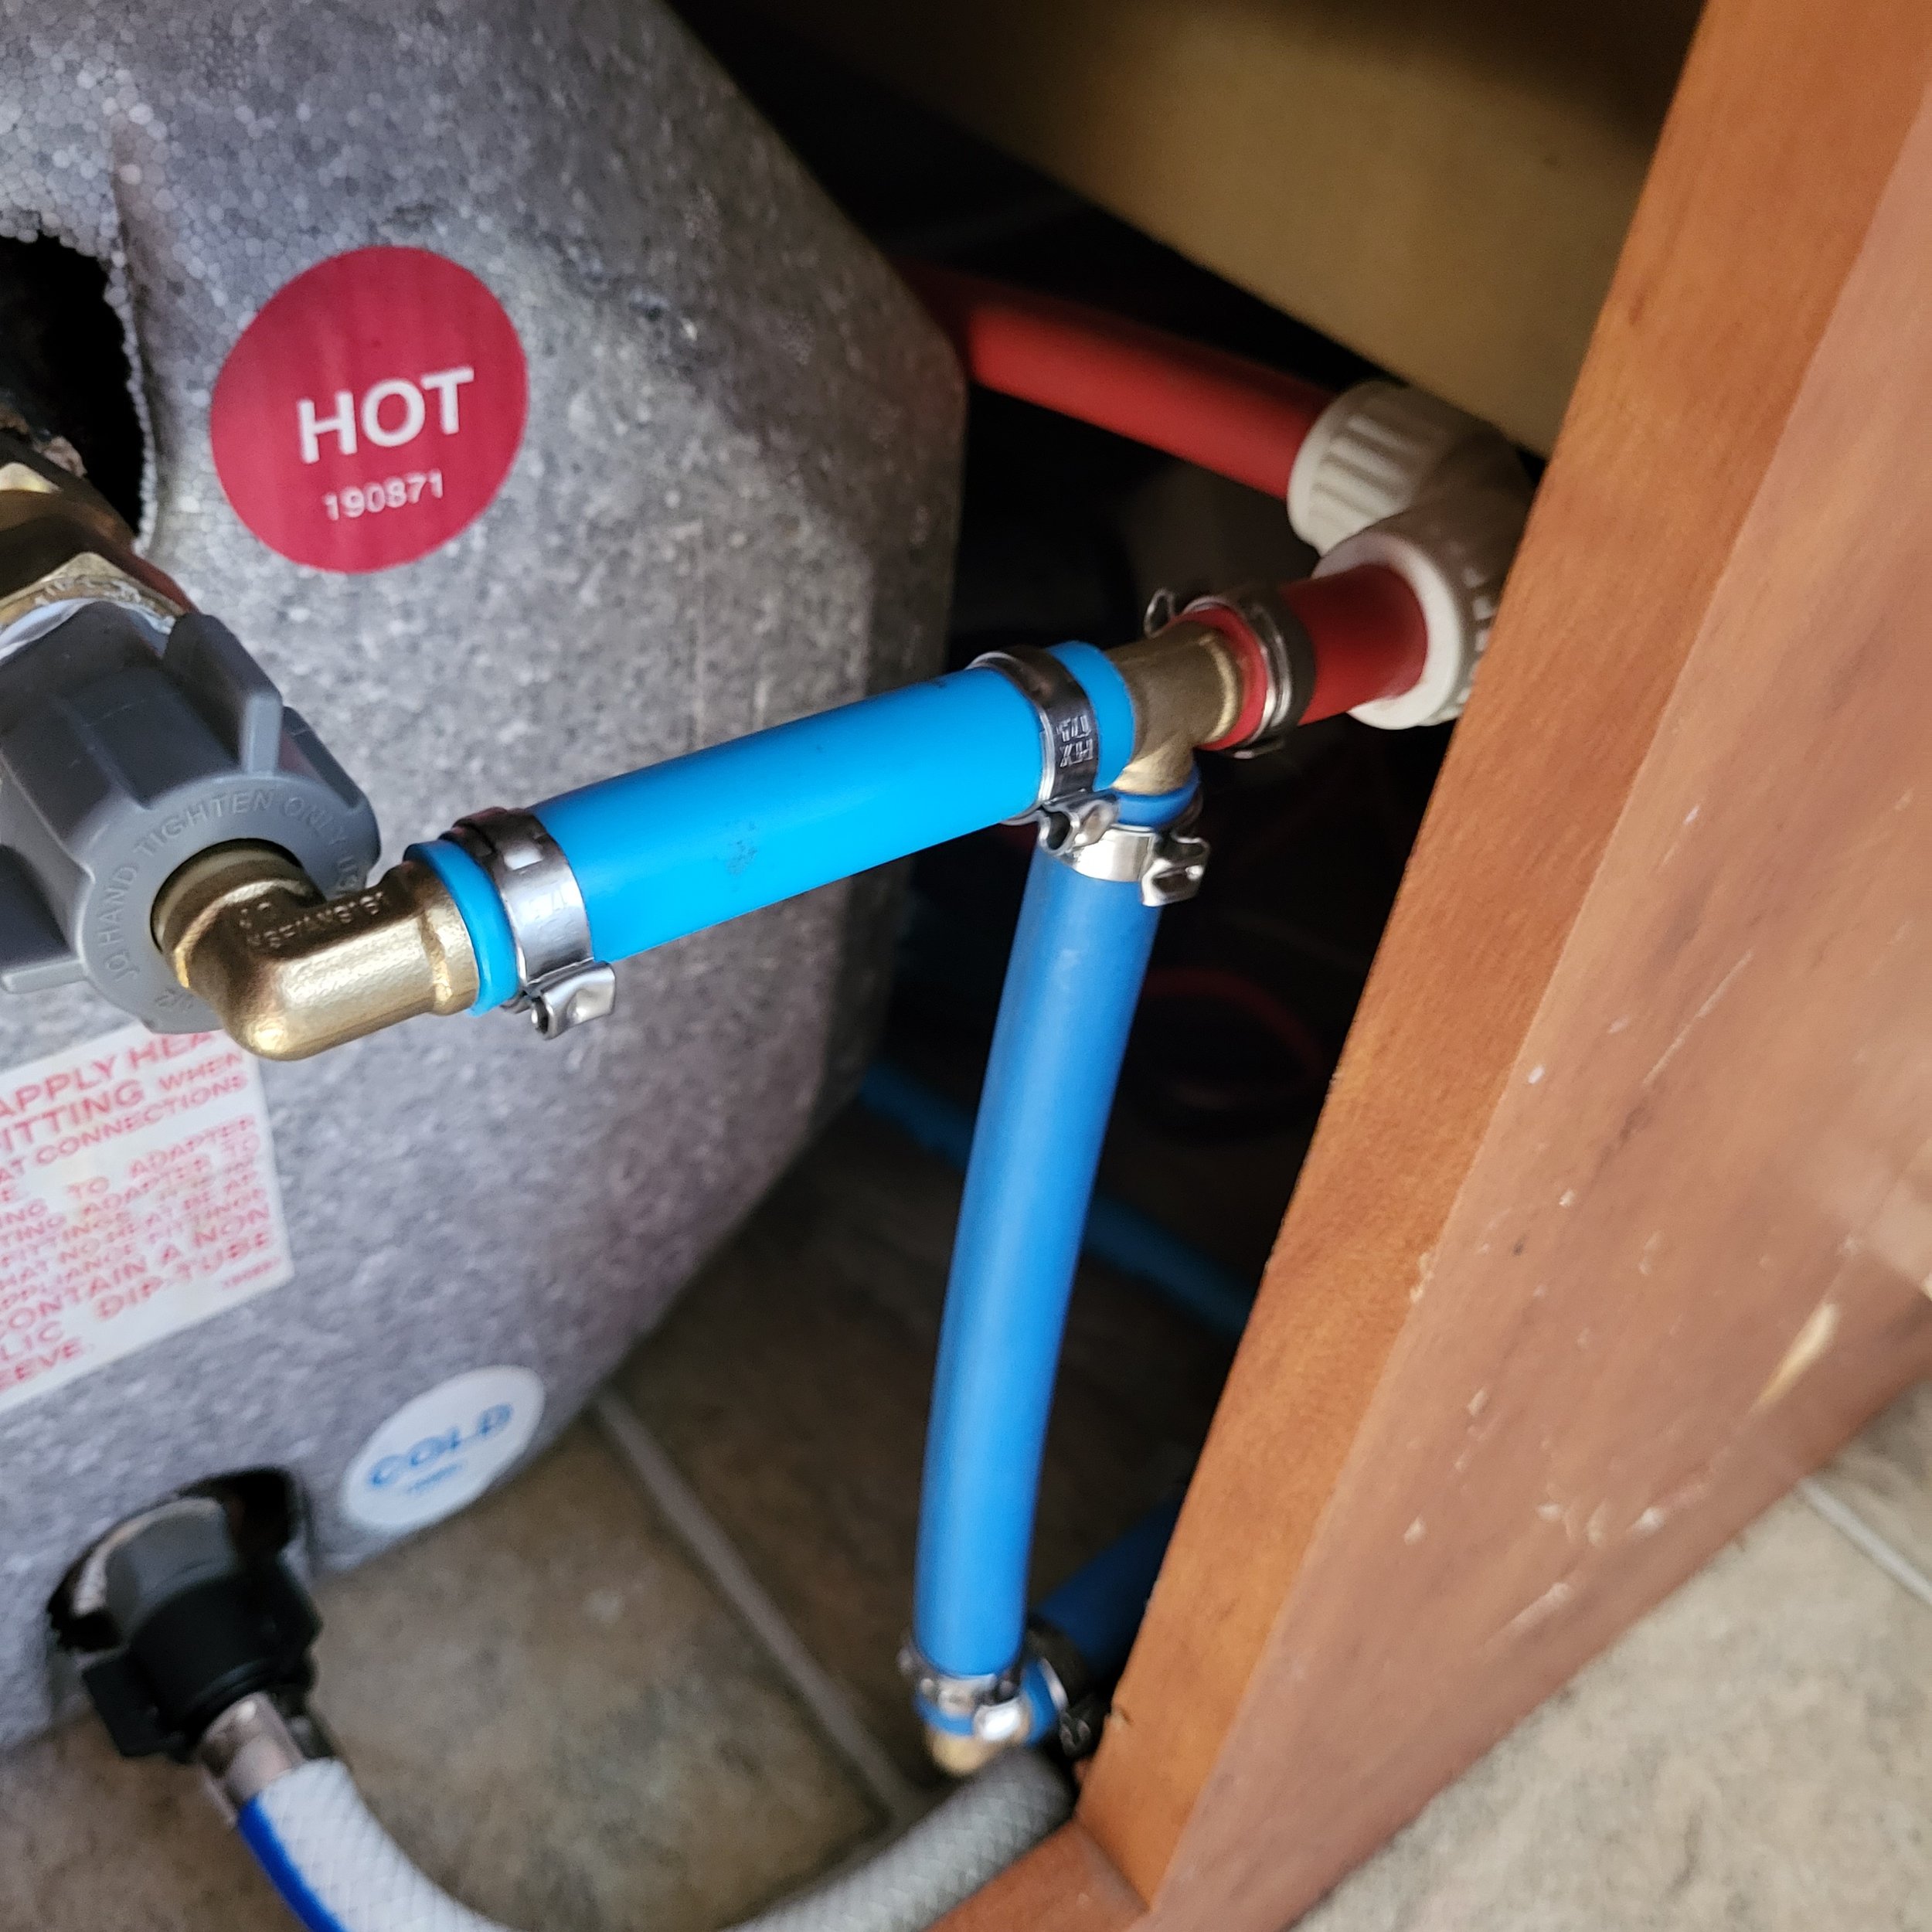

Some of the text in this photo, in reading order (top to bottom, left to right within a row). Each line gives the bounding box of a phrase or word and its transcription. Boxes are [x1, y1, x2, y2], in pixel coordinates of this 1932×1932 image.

[297, 365, 474, 464] HOT
[323, 468, 444, 521] 190871
[97, 865, 138, 946] HAND
[133, 787, 275, 858] TIGHTEN
[35, 1073, 248, 1167] CONNECTIONS
[367, 1402, 513, 1488] COLD
